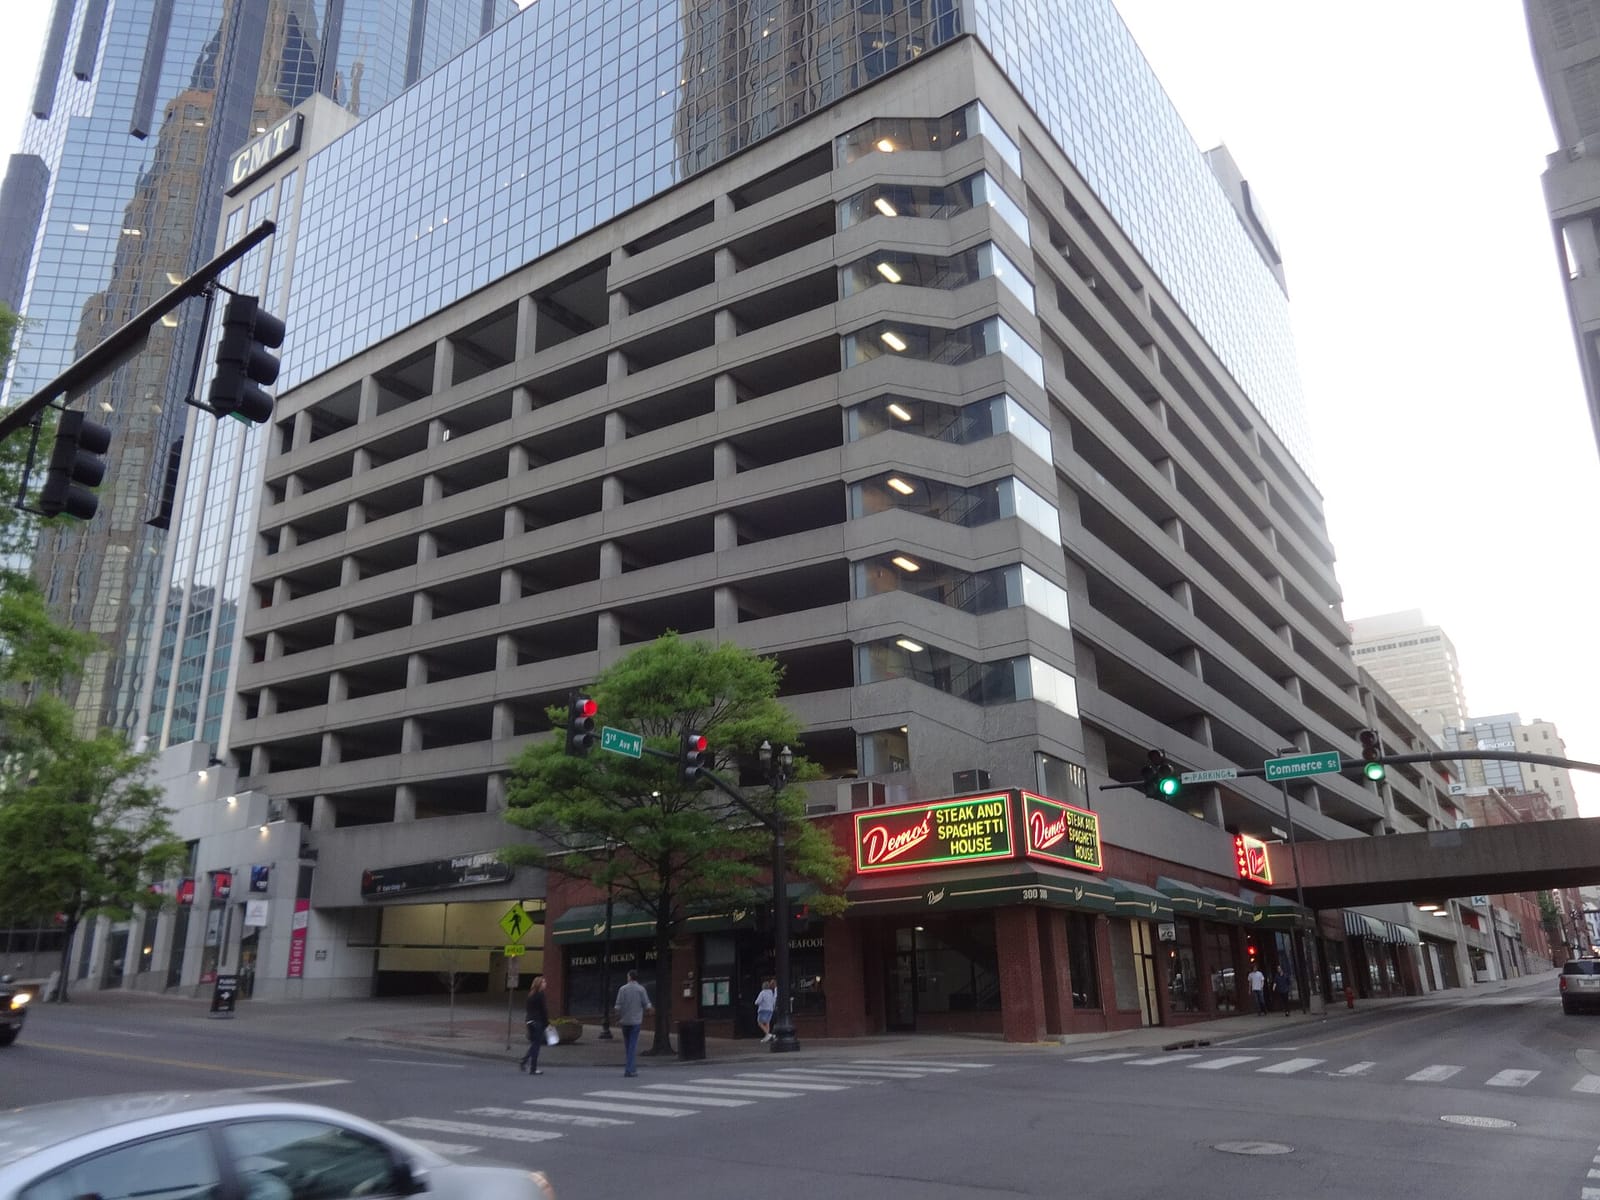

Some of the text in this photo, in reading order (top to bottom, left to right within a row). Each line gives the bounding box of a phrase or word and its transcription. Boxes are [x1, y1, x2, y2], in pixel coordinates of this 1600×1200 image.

[233, 120, 290, 184] CMT
[605, 733, 640, 753] 3rd Ave N
[1192, 770, 1228, 781] PARKING
[1269, 760, 1337, 776] Commerce St
[936, 802, 1003, 824] STEAK AND
[1066, 811, 1085, 828] STEAK
[938, 819, 1004, 841] SPAGHETTI
[950, 837, 993, 855] HOUSE
[1074, 844, 1094, 861] HOUSE
[1022, 889, 1038, 900] 300
[571, 955, 597, 966] STEAKS
